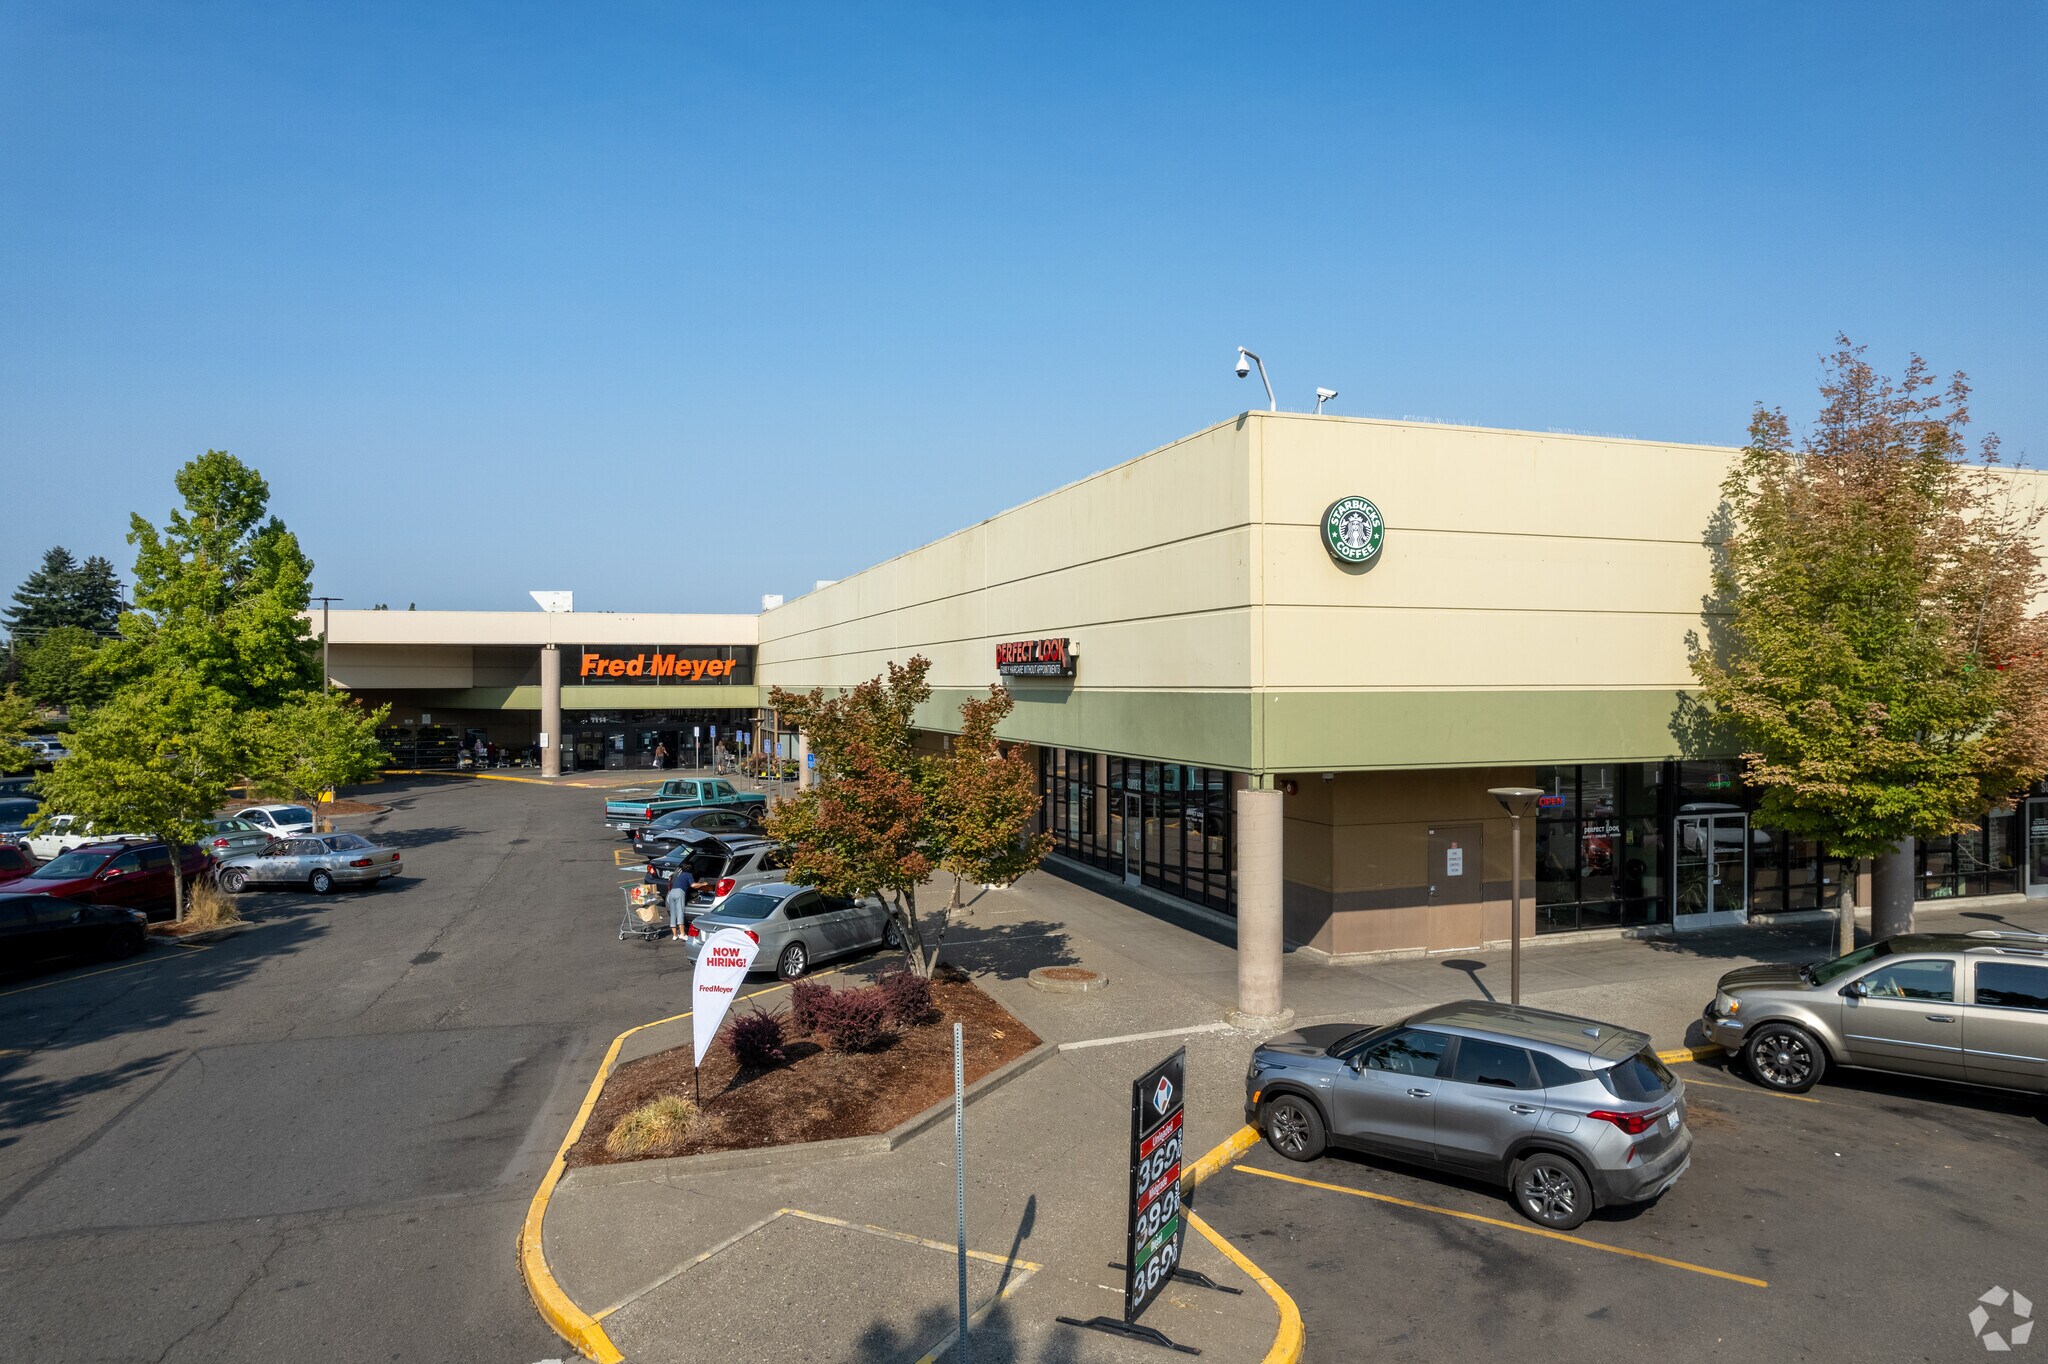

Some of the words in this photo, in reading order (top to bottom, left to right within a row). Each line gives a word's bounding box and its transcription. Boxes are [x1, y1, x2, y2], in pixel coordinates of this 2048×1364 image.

[1331, 500, 1380, 528] STARBUCKS
[1336, 541, 1375, 558] COFFEE
[996, 640, 1034, 669] PERFECT
[1037, 638, 1067, 668] LOOK
[580, 653, 645, 677] Fred
[650, 653, 737, 681] Meyer
[1539, 797, 1562, 806] OPEN
[1584, 826, 1605, 834] PERFECT
[1606, 825, 1620, 833] LOOK
[713, 947, 741, 957] NOW
[706, 957, 747, 968] HIRING!
